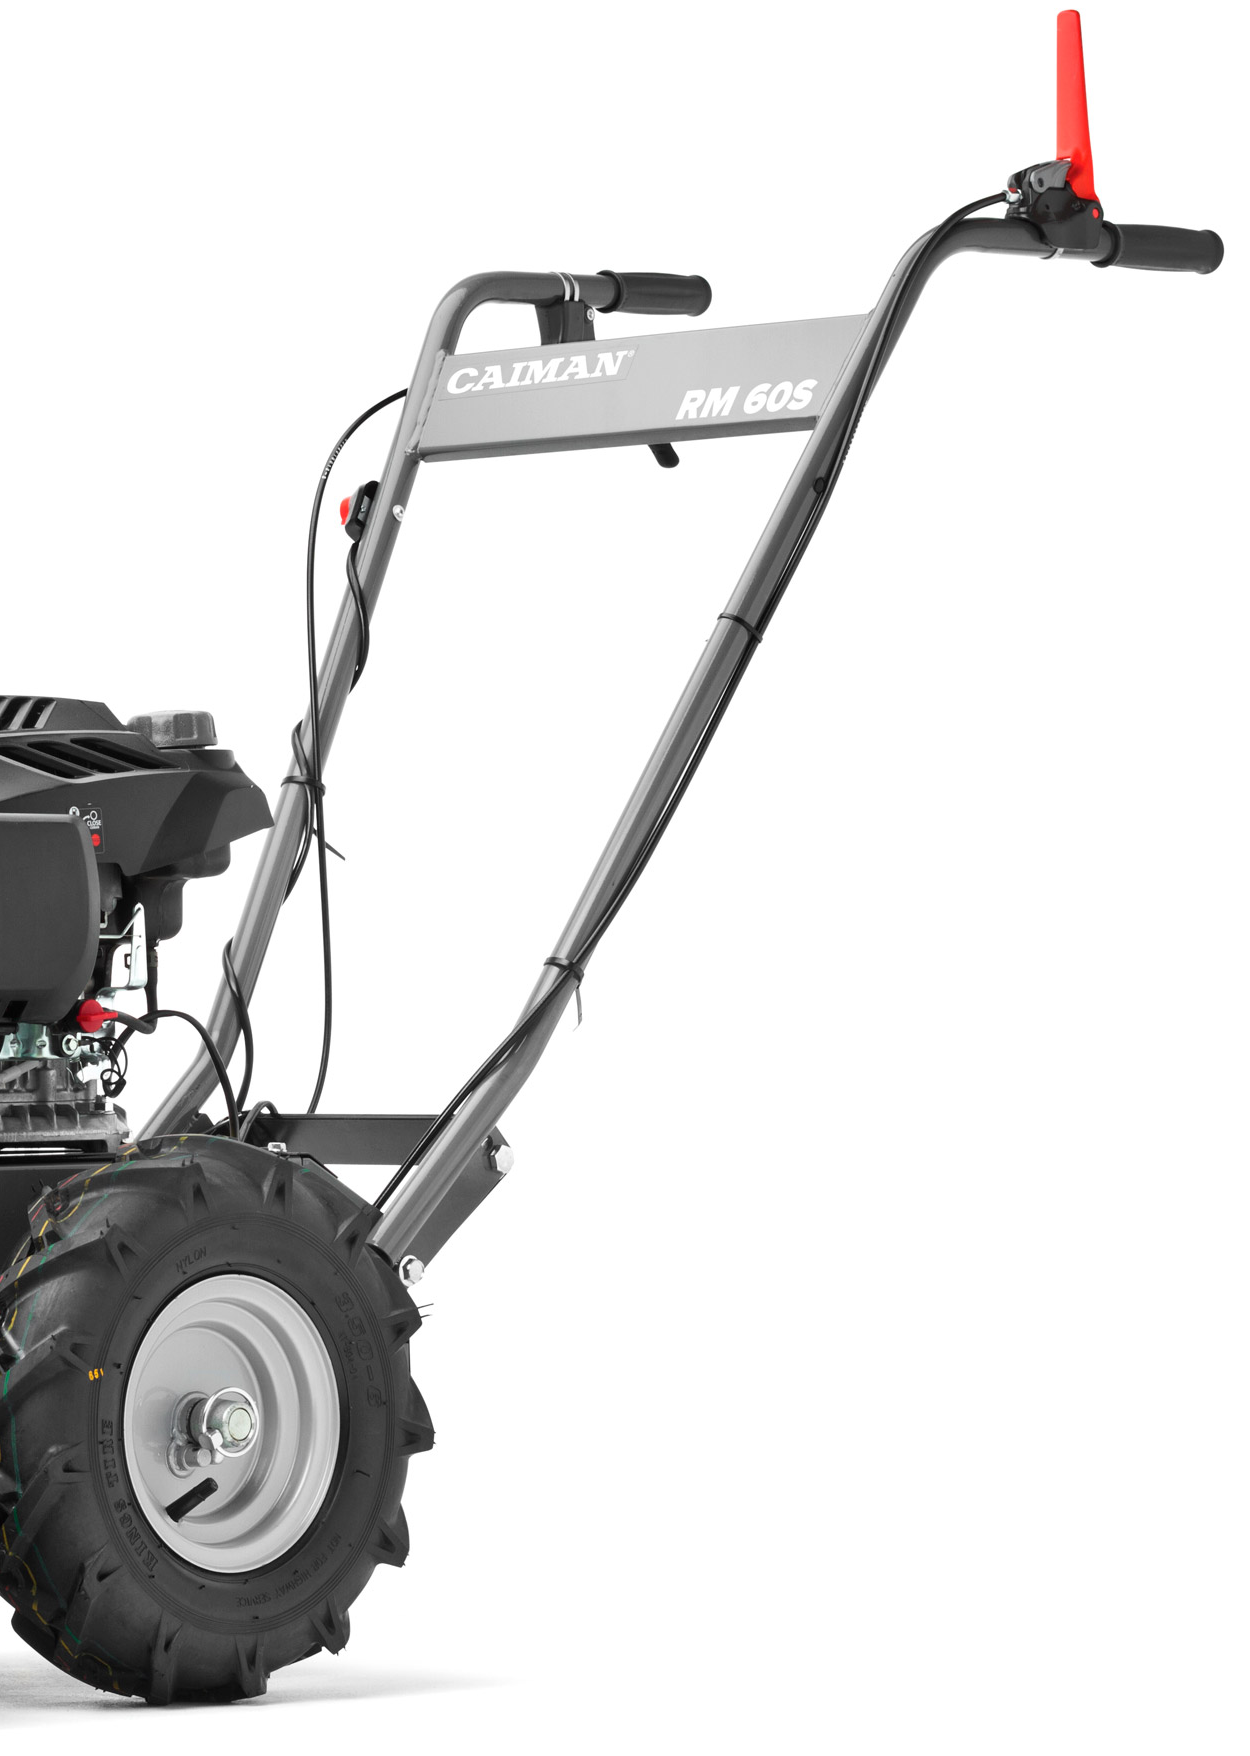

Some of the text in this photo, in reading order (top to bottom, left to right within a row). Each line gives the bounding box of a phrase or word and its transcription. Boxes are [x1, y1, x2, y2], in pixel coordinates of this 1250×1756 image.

[675, 379, 819, 420] RM 60S
[175, 1246, 207, 1272] NYLON
[113, 1498, 159, 1572] KINGS
[235, 1591, 272, 1608] SERVICE
